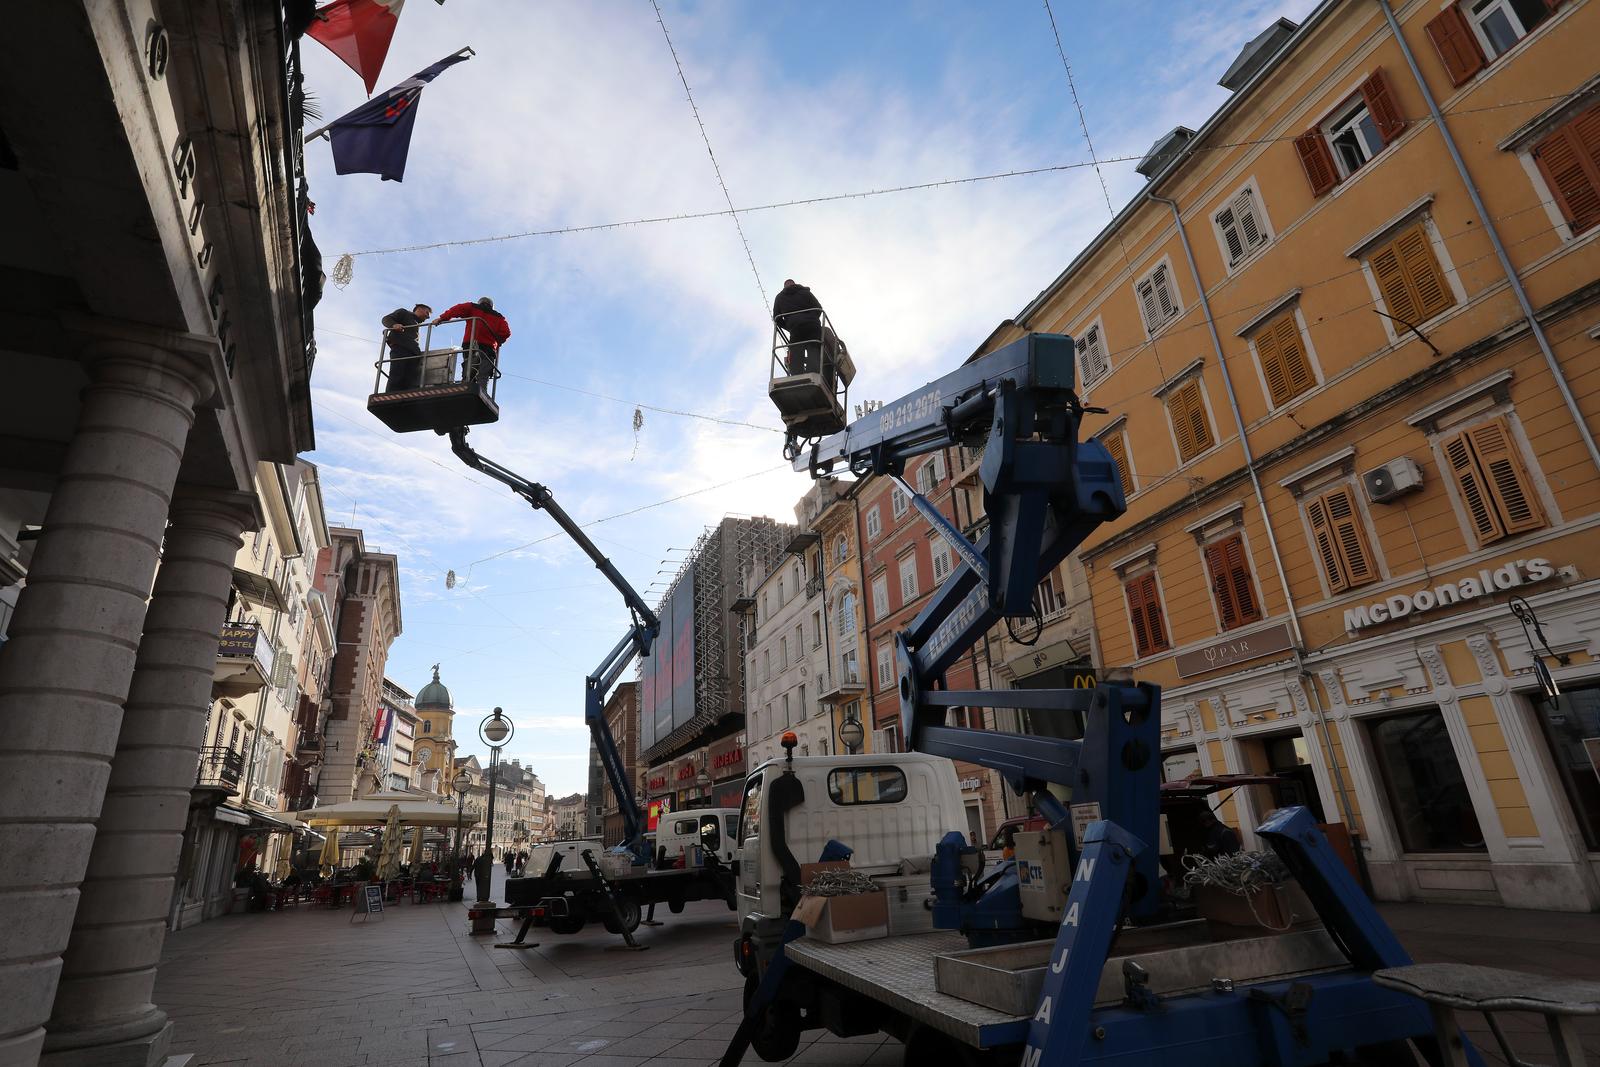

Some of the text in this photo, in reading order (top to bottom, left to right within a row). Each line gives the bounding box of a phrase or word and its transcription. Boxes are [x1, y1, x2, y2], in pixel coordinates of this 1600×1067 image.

[896, 402, 913, 427] 213
[1344, 557, 1554, 632] McDonald's
[928, 599, 977, 661] ELEKTRO
[220, 640, 254, 648] OSTEL
[1219, 640, 1250, 658] PAR
[712, 748, 744, 769] RIJEKA
